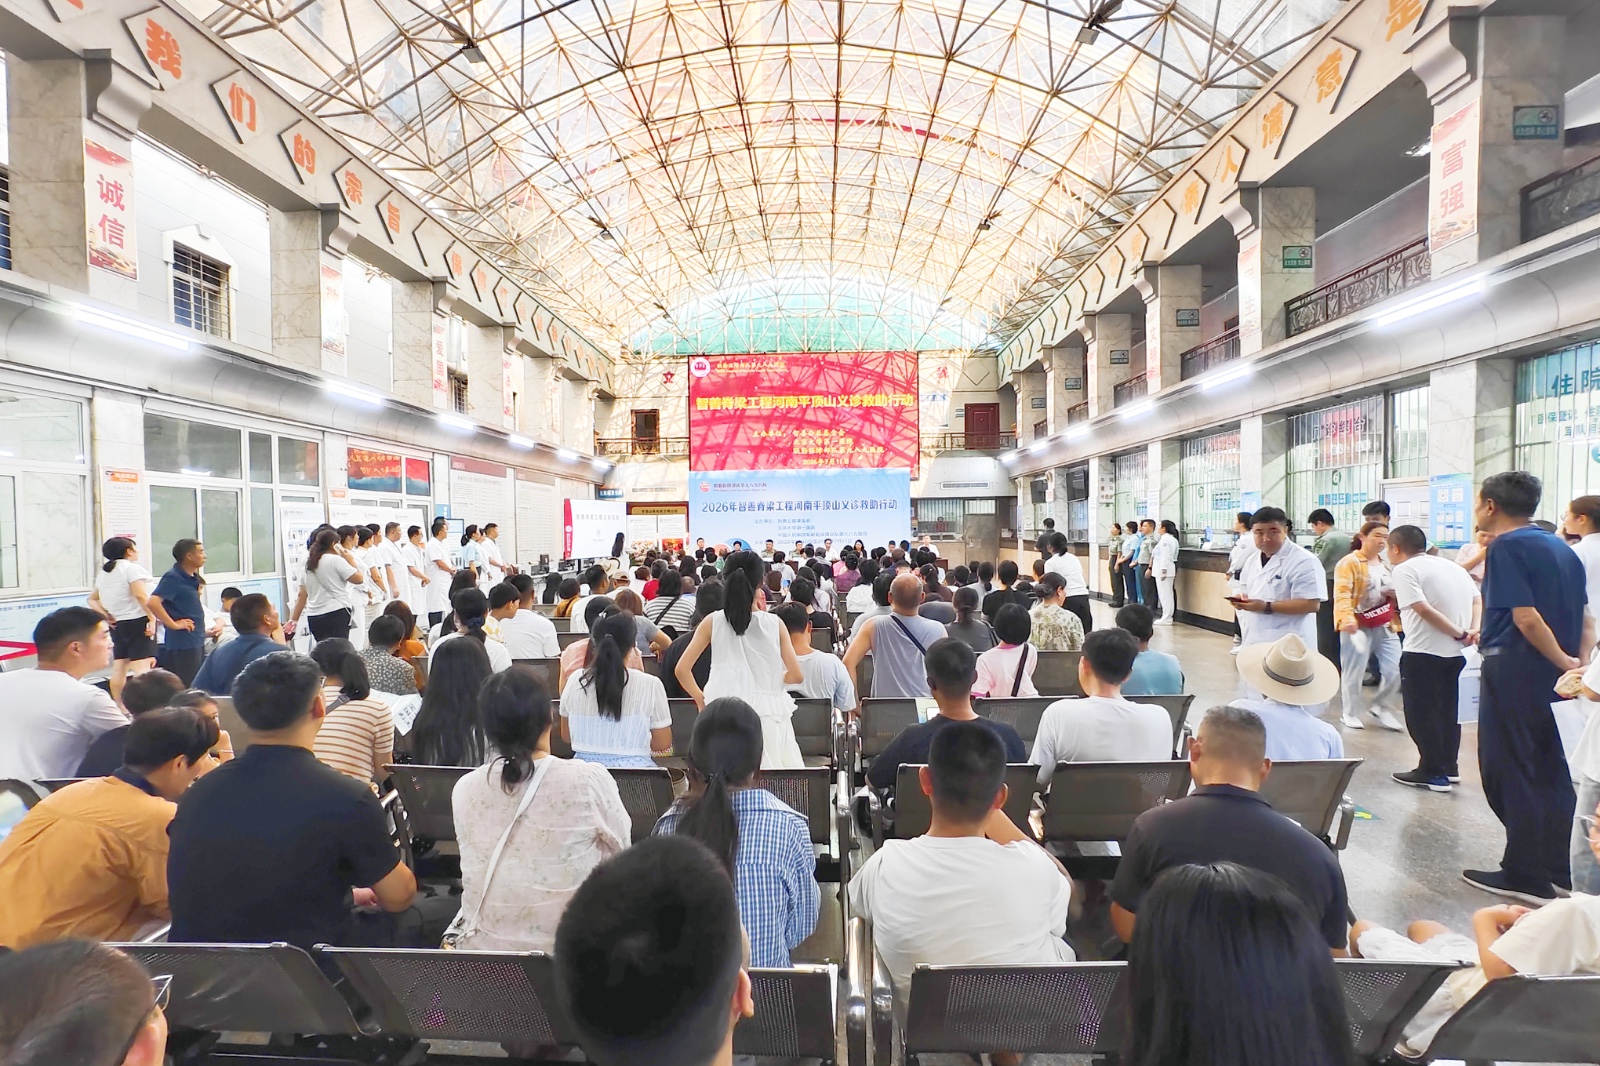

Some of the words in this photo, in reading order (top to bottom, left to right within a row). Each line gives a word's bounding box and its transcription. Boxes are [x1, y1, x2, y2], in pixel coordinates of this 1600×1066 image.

[1440, 138, 1466, 219] 富强
[97, 174, 126, 249] 诚信
[1551, 367, 1600, 398] 住院
[696, 394, 914, 411] 智善脊梁工程河南平顶山义诊救助行动
[702, 499, 897, 512] 2026年智善脊梁工程河南平顶山义诊救助行动
